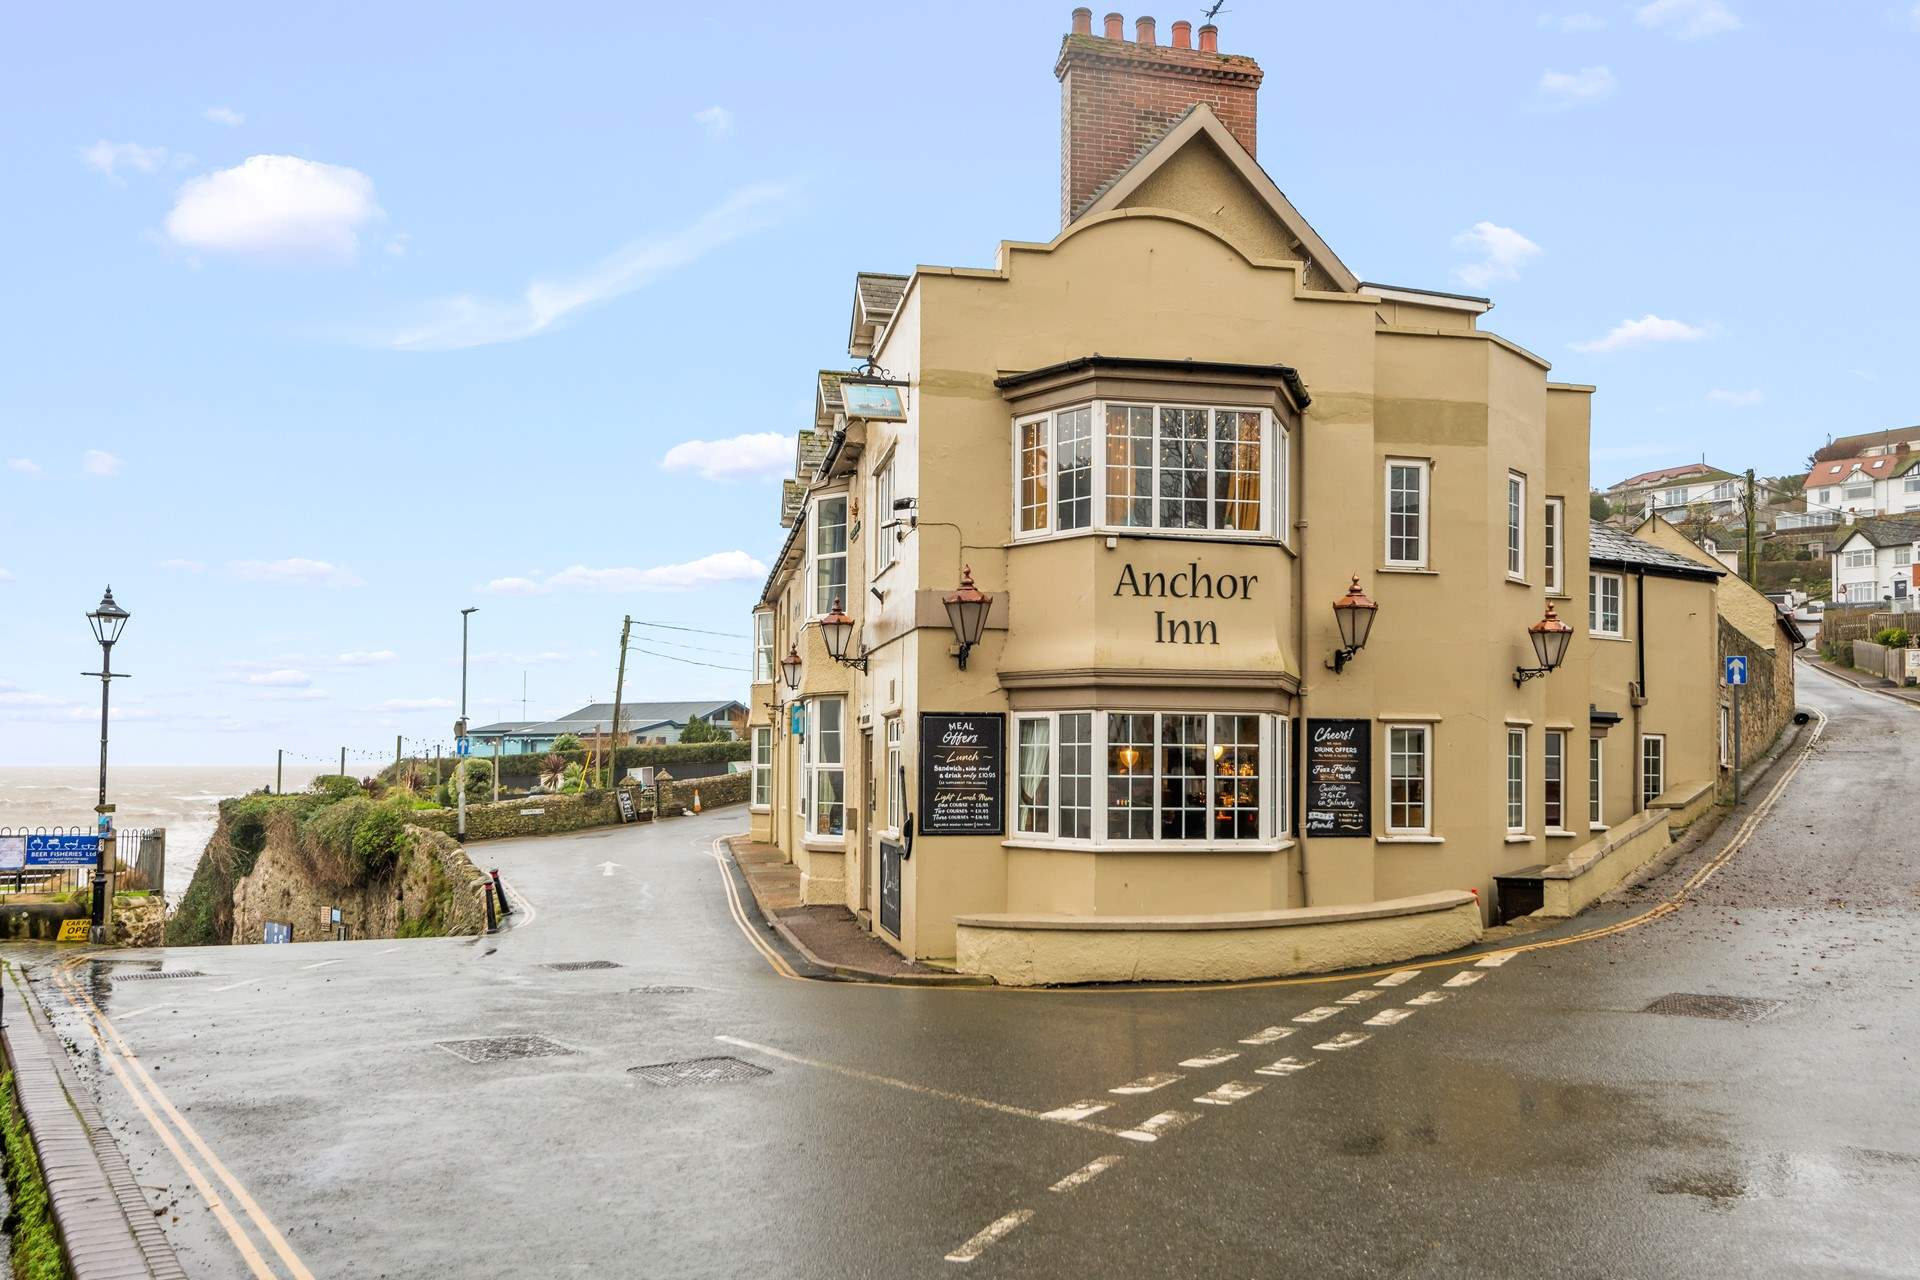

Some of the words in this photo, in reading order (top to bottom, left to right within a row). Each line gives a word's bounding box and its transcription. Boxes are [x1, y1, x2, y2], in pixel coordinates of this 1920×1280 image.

[1113, 563, 1258, 600] Anchor
[1154, 611, 1220, 645] Inn
[948, 722, 974, 730] MEAL
[942, 731, 978, 746] Offers
[1314, 727, 1354, 742] Cheers!
[946, 750, 980, 763] Lunch
[956, 792, 976, 801] Lunch
[1327, 799, 1355, 808] Saturday
